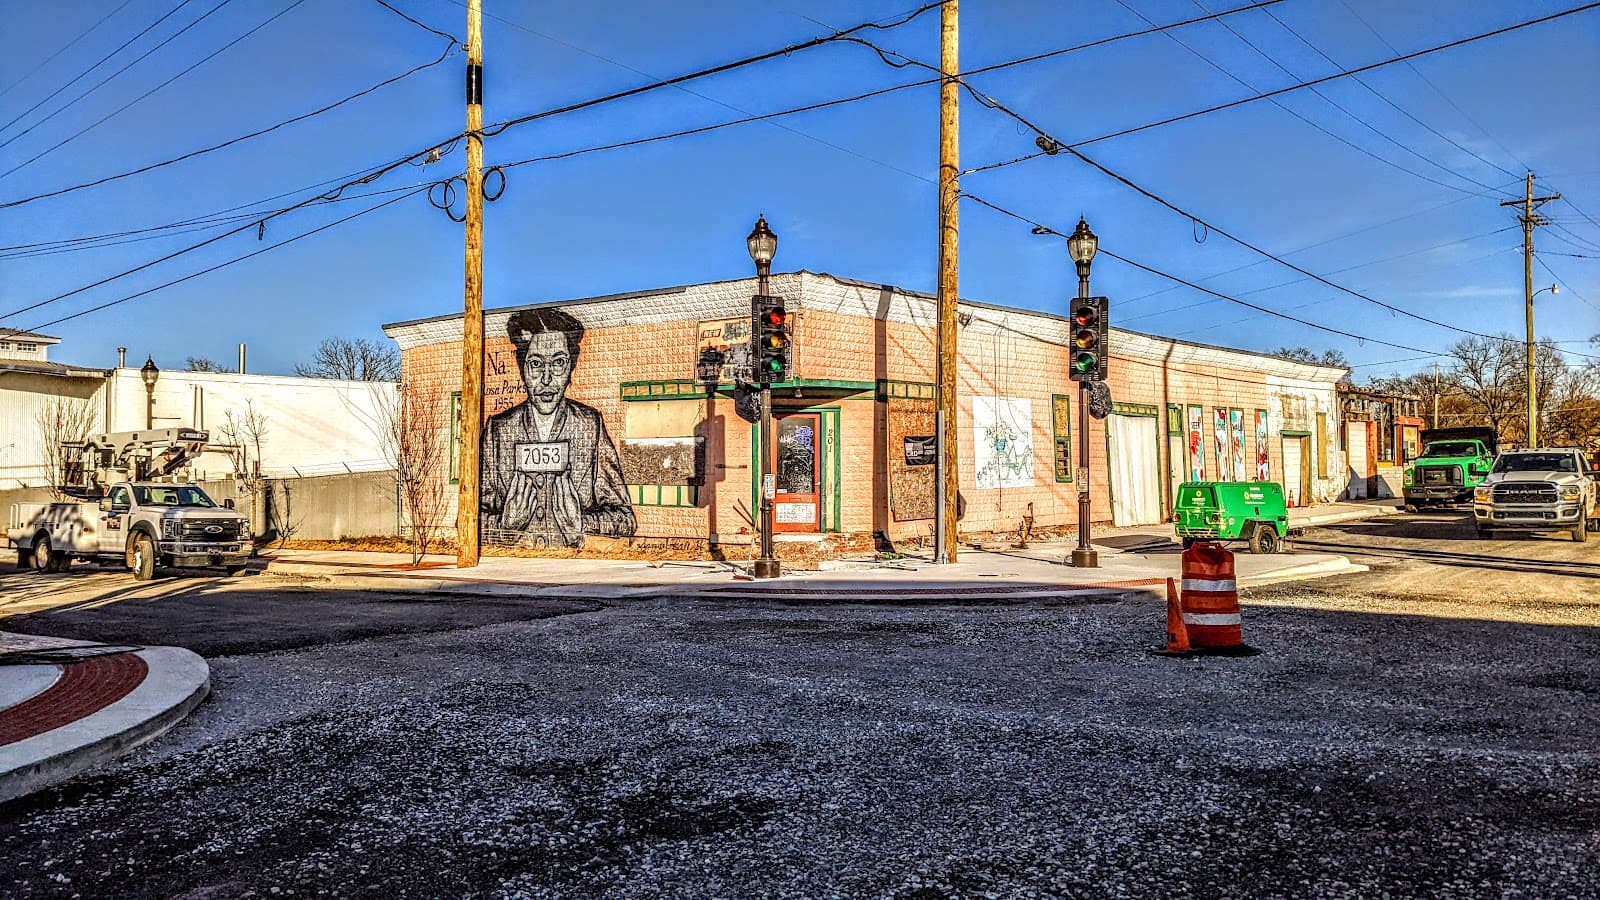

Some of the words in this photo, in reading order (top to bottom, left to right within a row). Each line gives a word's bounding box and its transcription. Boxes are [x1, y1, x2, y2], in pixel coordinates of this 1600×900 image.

[501, 380, 527, 394] Parks
[493, 397, 514, 410] 1955
[523, 447, 561, 465] 7053
